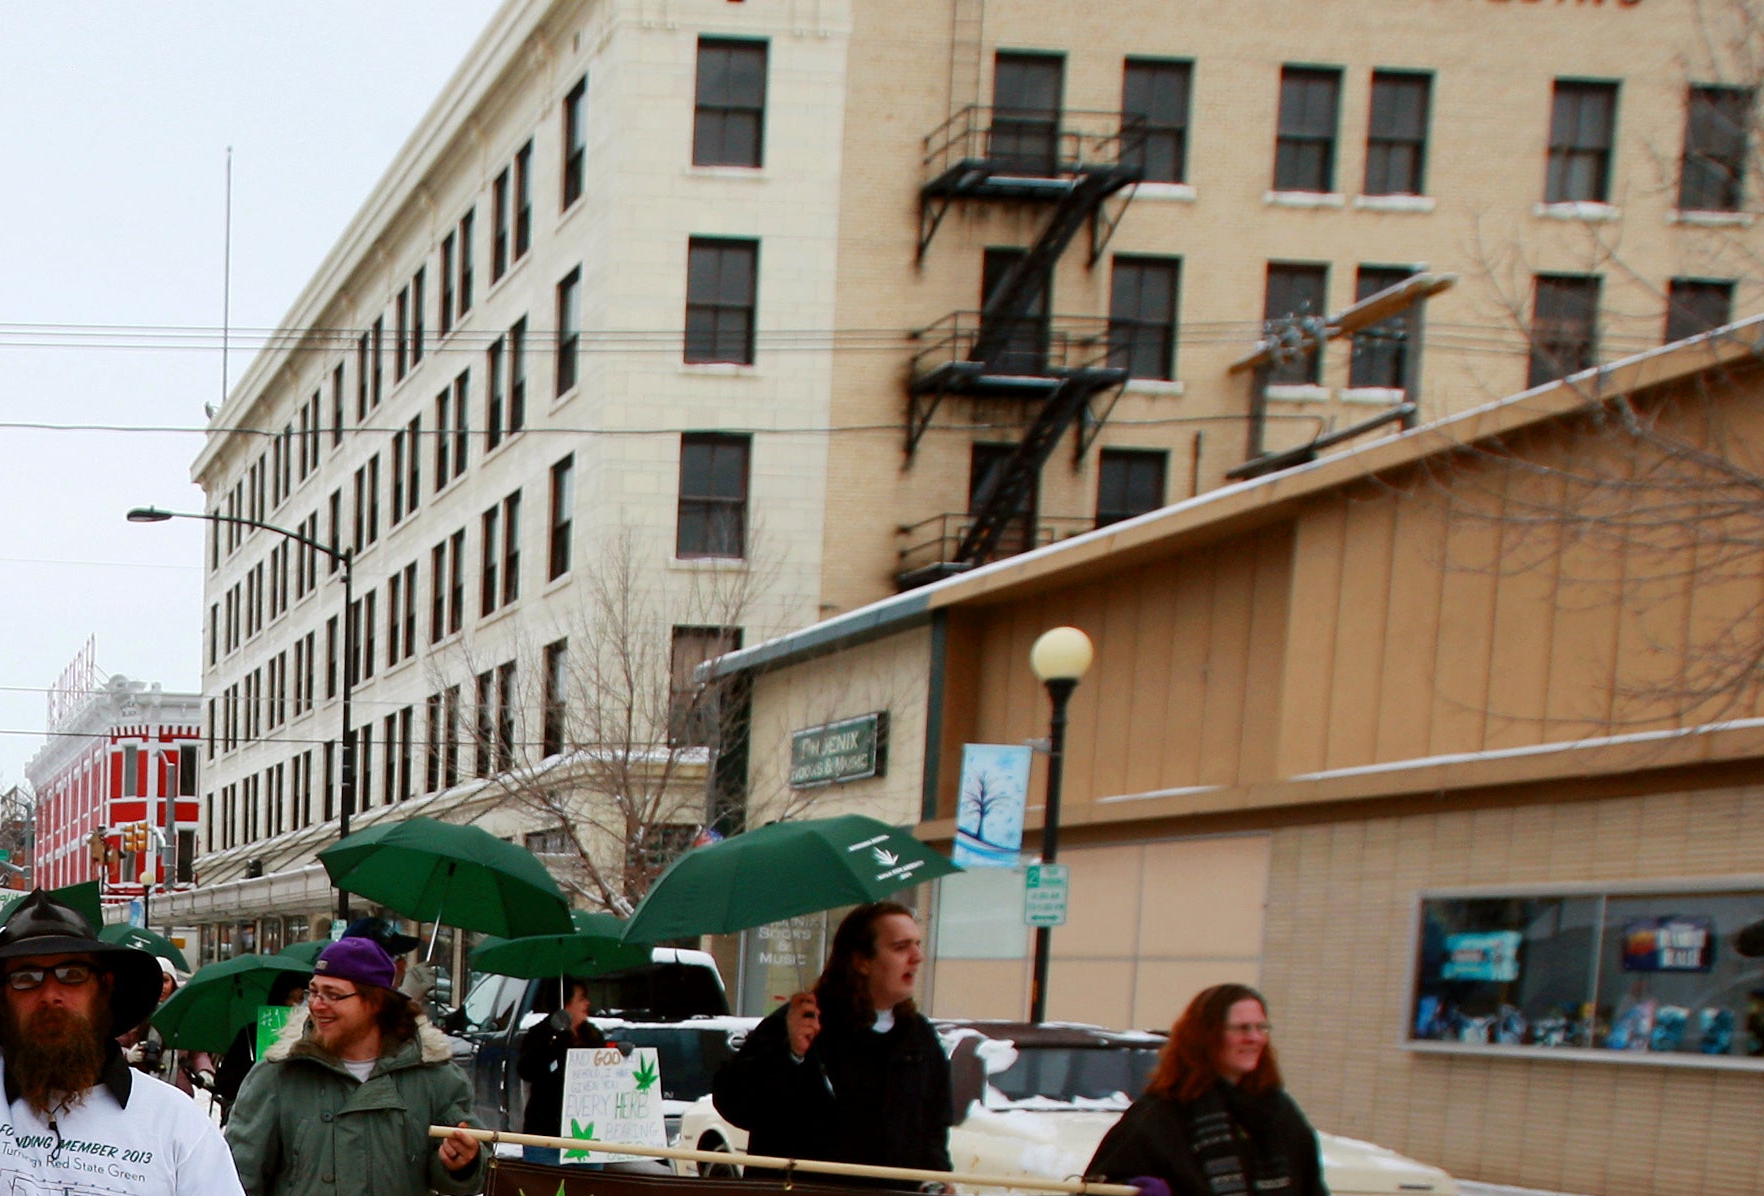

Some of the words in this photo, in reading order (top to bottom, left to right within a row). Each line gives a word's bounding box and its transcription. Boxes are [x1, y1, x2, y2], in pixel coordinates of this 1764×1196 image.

[759, 951, 807, 965] MUSIC
[593, 1050, 621, 1067] GOD
[566, 1094, 611, 1118] EVERY
[614, 1091, 650, 1119] HERB
[59, 1139, 119, 1159] MEMBER
[122, 1149, 153, 1164] 2013
[73, 1157, 105, 1175] State
[108, 1163, 146, 1183] Green
